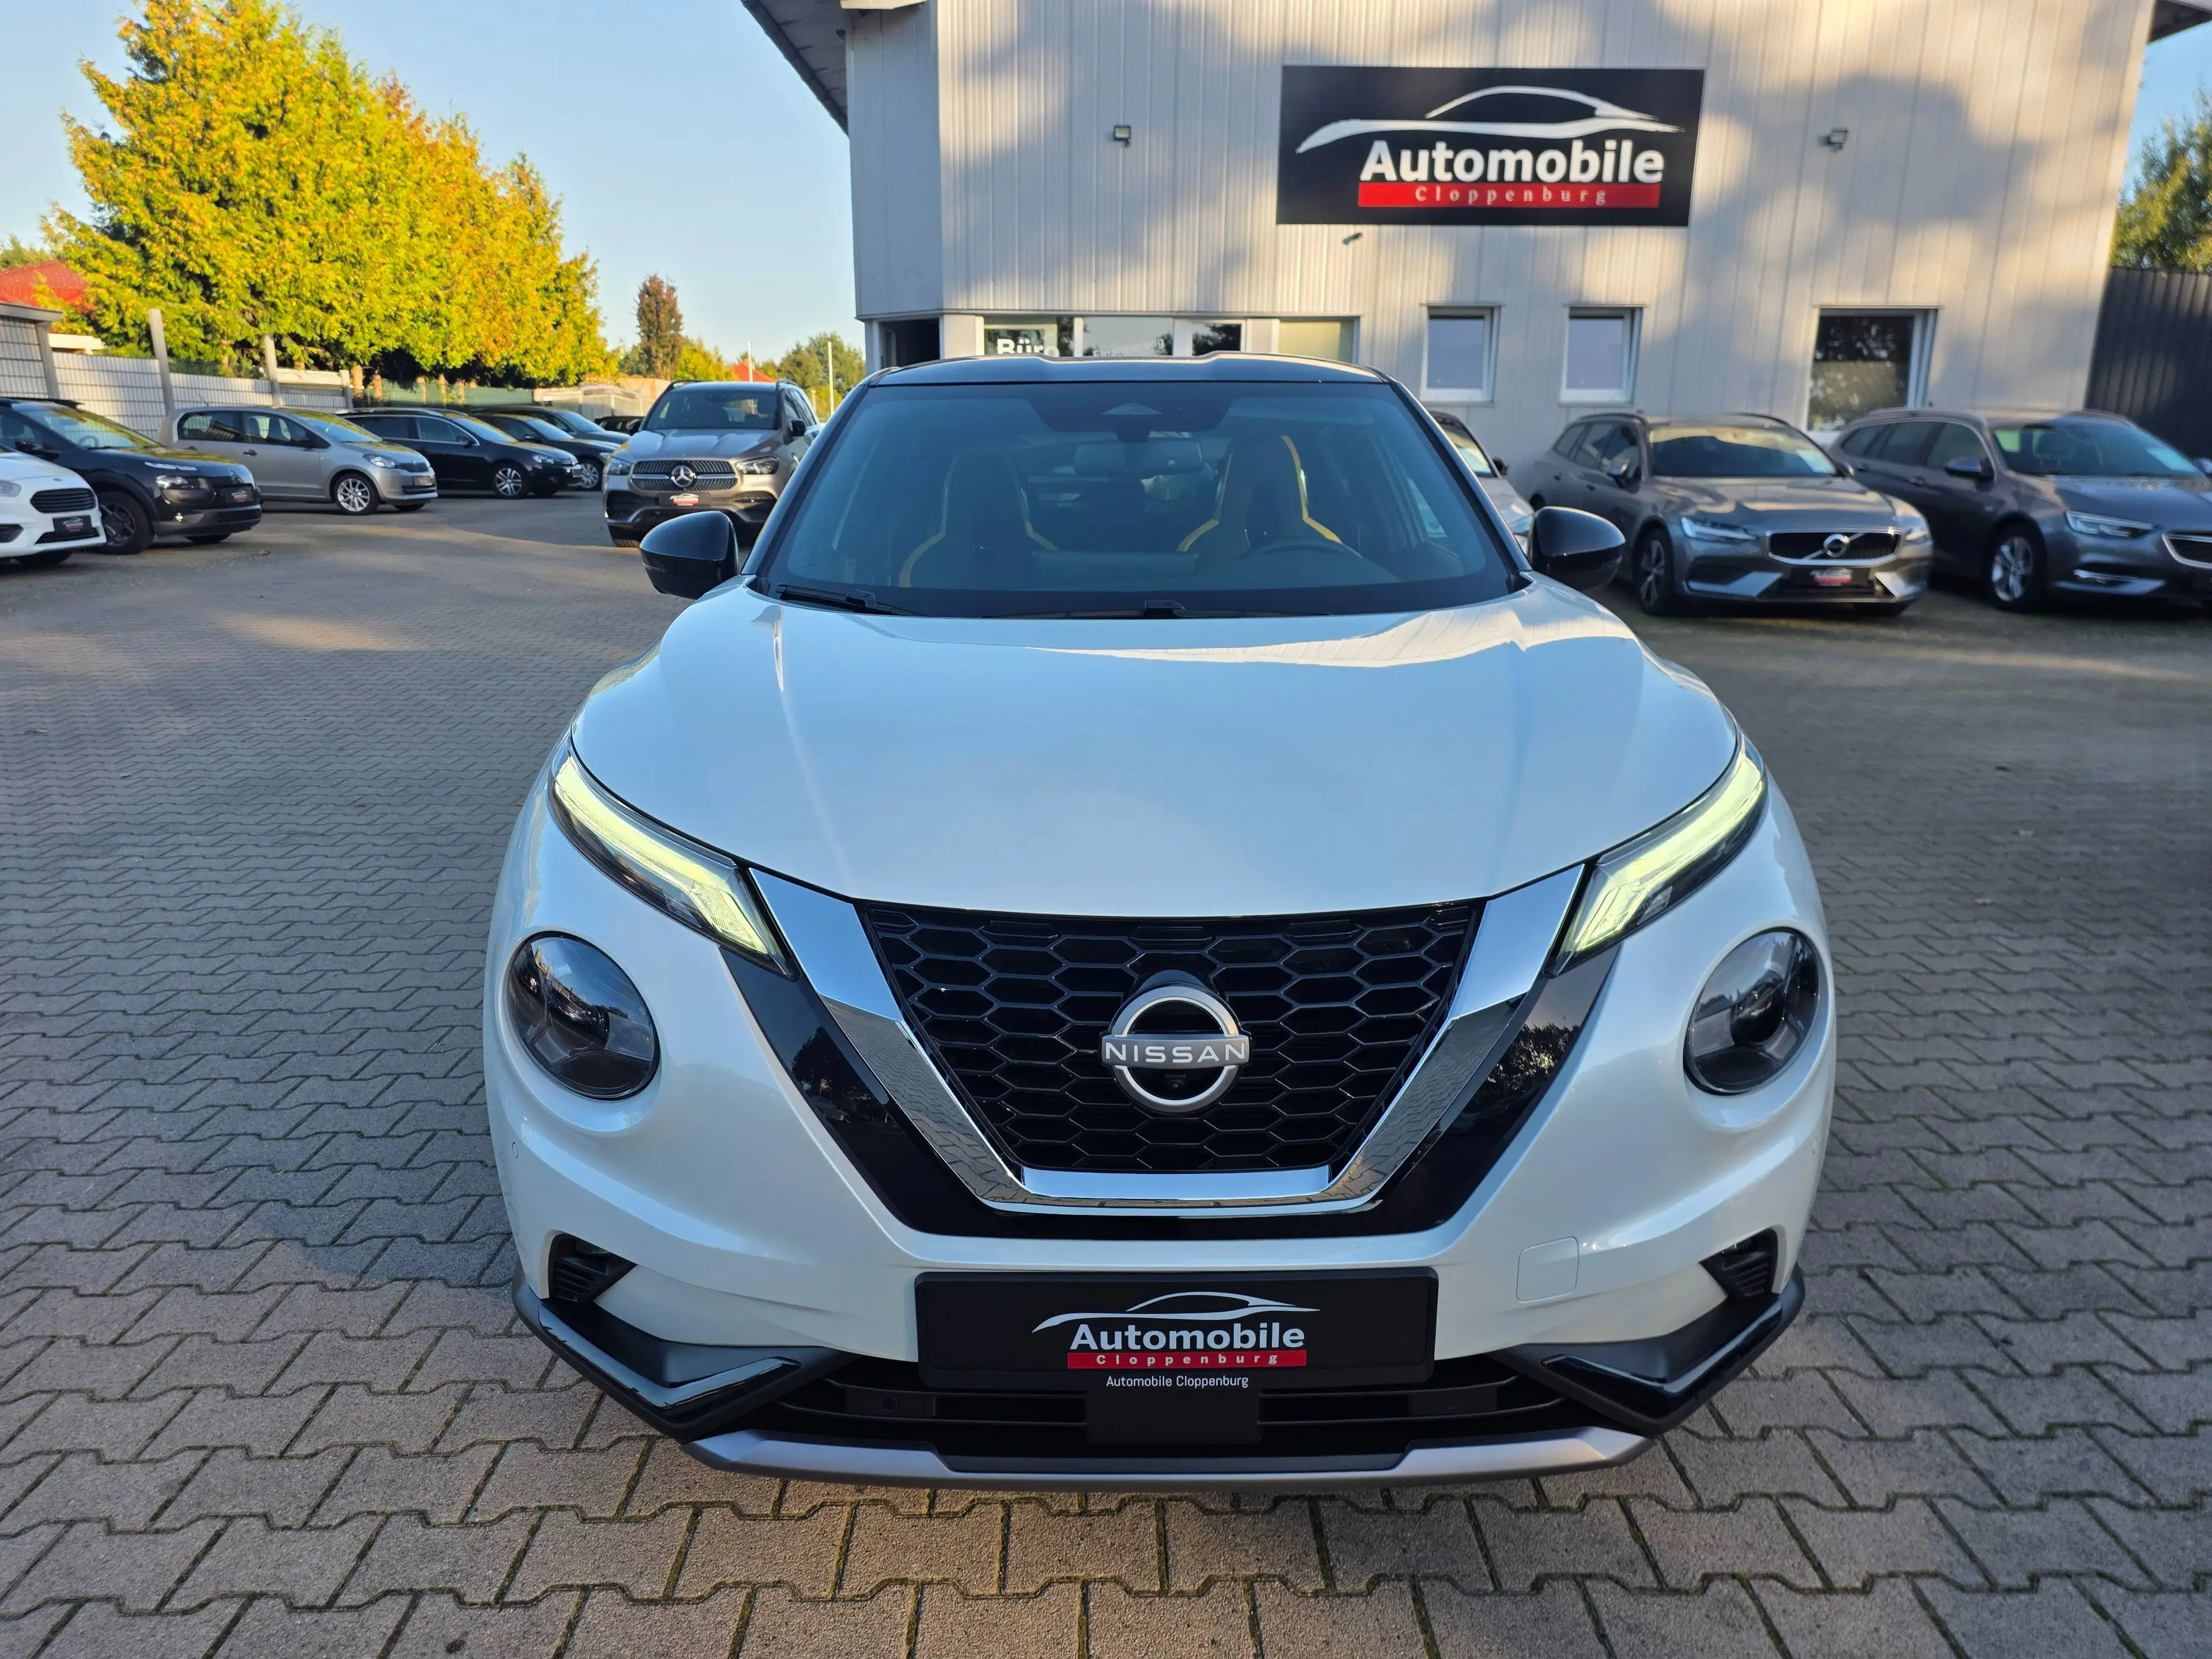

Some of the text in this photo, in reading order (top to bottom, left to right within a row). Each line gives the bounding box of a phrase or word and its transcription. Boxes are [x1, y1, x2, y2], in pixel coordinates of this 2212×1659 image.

[1359, 140, 1664, 183] Automobile
[1415, 187, 1607, 206] Cloppenburg
[997, 338, 1059, 357] Büro
[1105, 1042, 1245, 1063] NISSAN
[1070, 1322, 1305, 1350] Automobile
[1096, 1354, 1278, 1365] Cloppenburg
[1106, 1376, 1249, 1388] Automobile Cloppenburg
